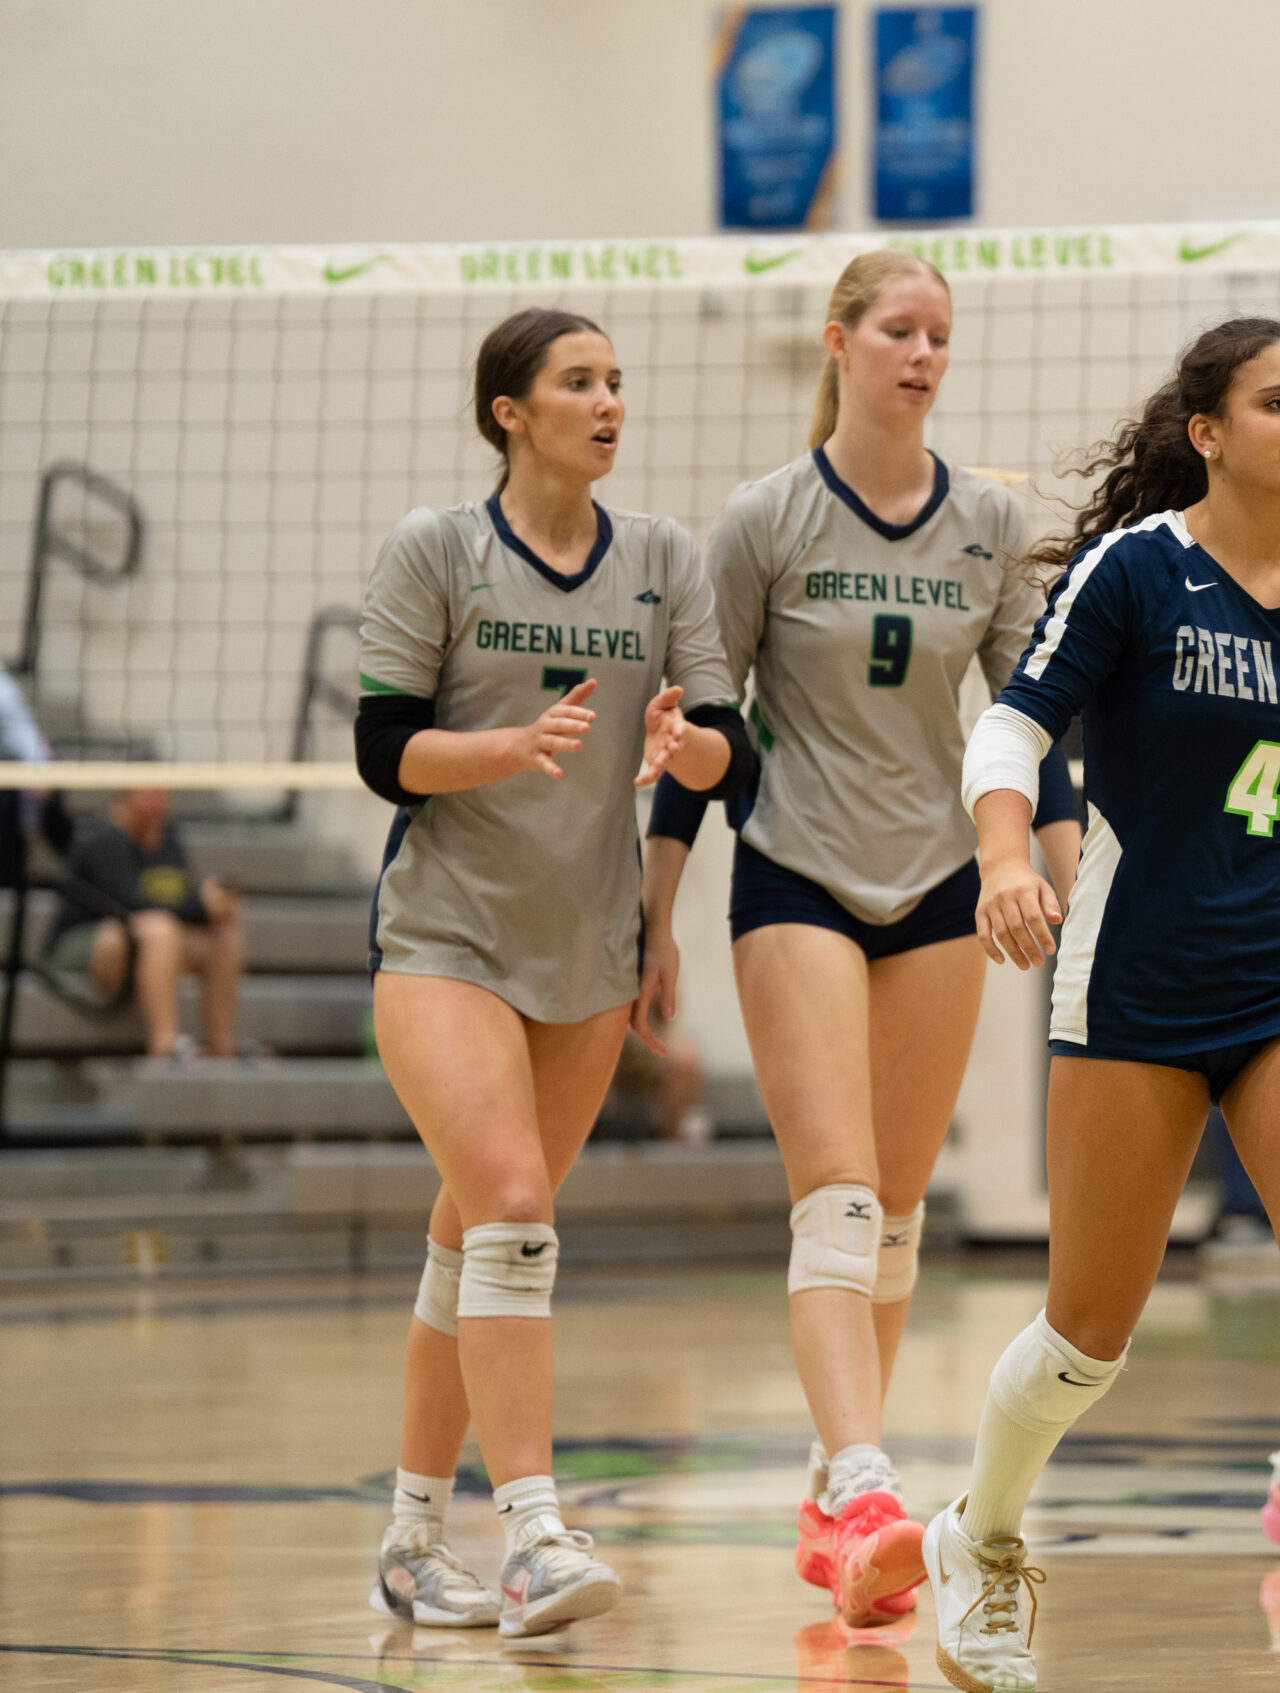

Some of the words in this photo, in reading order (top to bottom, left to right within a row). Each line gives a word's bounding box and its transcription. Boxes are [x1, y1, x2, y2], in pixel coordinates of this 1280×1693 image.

[47, 256, 157, 288] GREEN
[168, 254, 264, 286] LEVEL
[458, 249, 572, 283] GREEN
[582, 246, 682, 279] LEVEL
[1011, 233, 1114, 269] LEVEL
[806, 570, 887, 603] GREEN
[895, 574, 971, 612] LEVEL
[476, 620, 563, 655] GREEN
[570, 625, 647, 662] LEVEL
[867, 612, 914, 688] 9
[1172, 625, 1278, 705] GREEN
